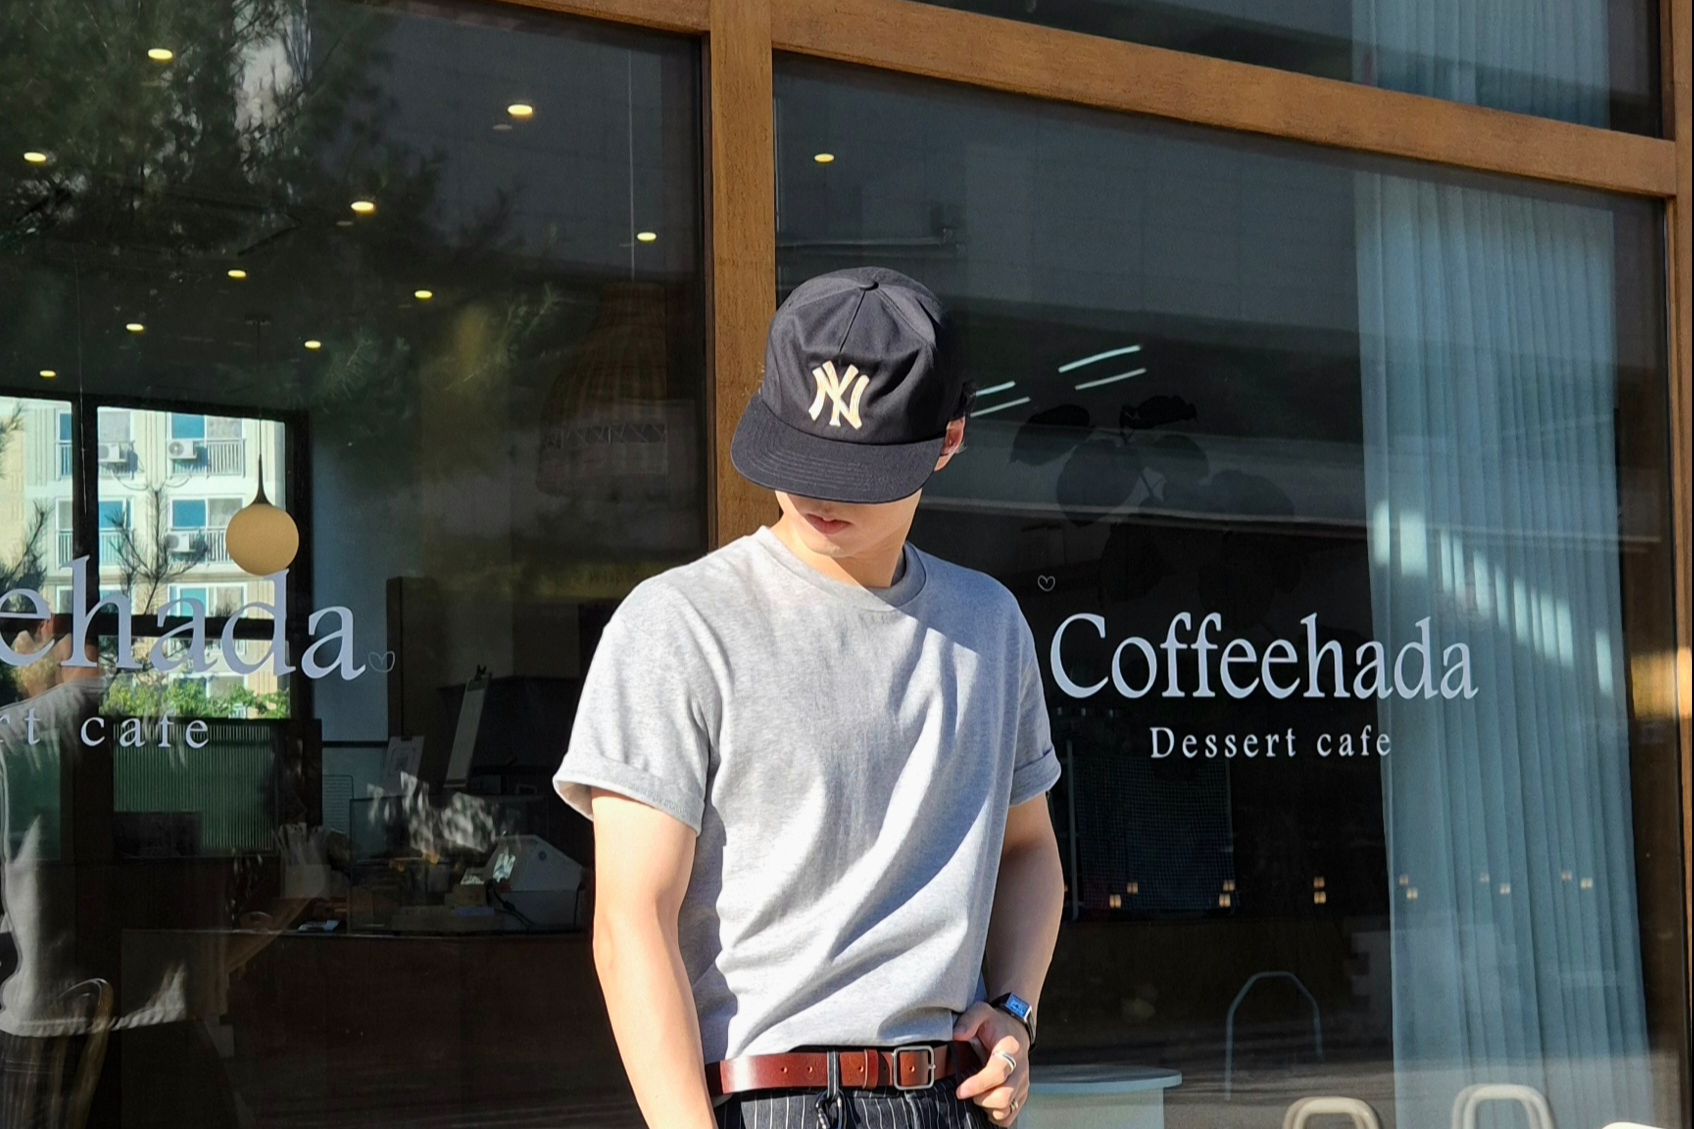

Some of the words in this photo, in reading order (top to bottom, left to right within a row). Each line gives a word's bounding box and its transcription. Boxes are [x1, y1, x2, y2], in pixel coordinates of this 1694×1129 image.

[808, 360, 870, 430] NY
[0, 555, 366, 680] ehada
[1050, 611, 1479, 699] Coffeehada
[80, 708, 209, 749] cafe
[1150, 726, 1297, 758] Dessert
[1316, 725, 1391, 756] cafe
